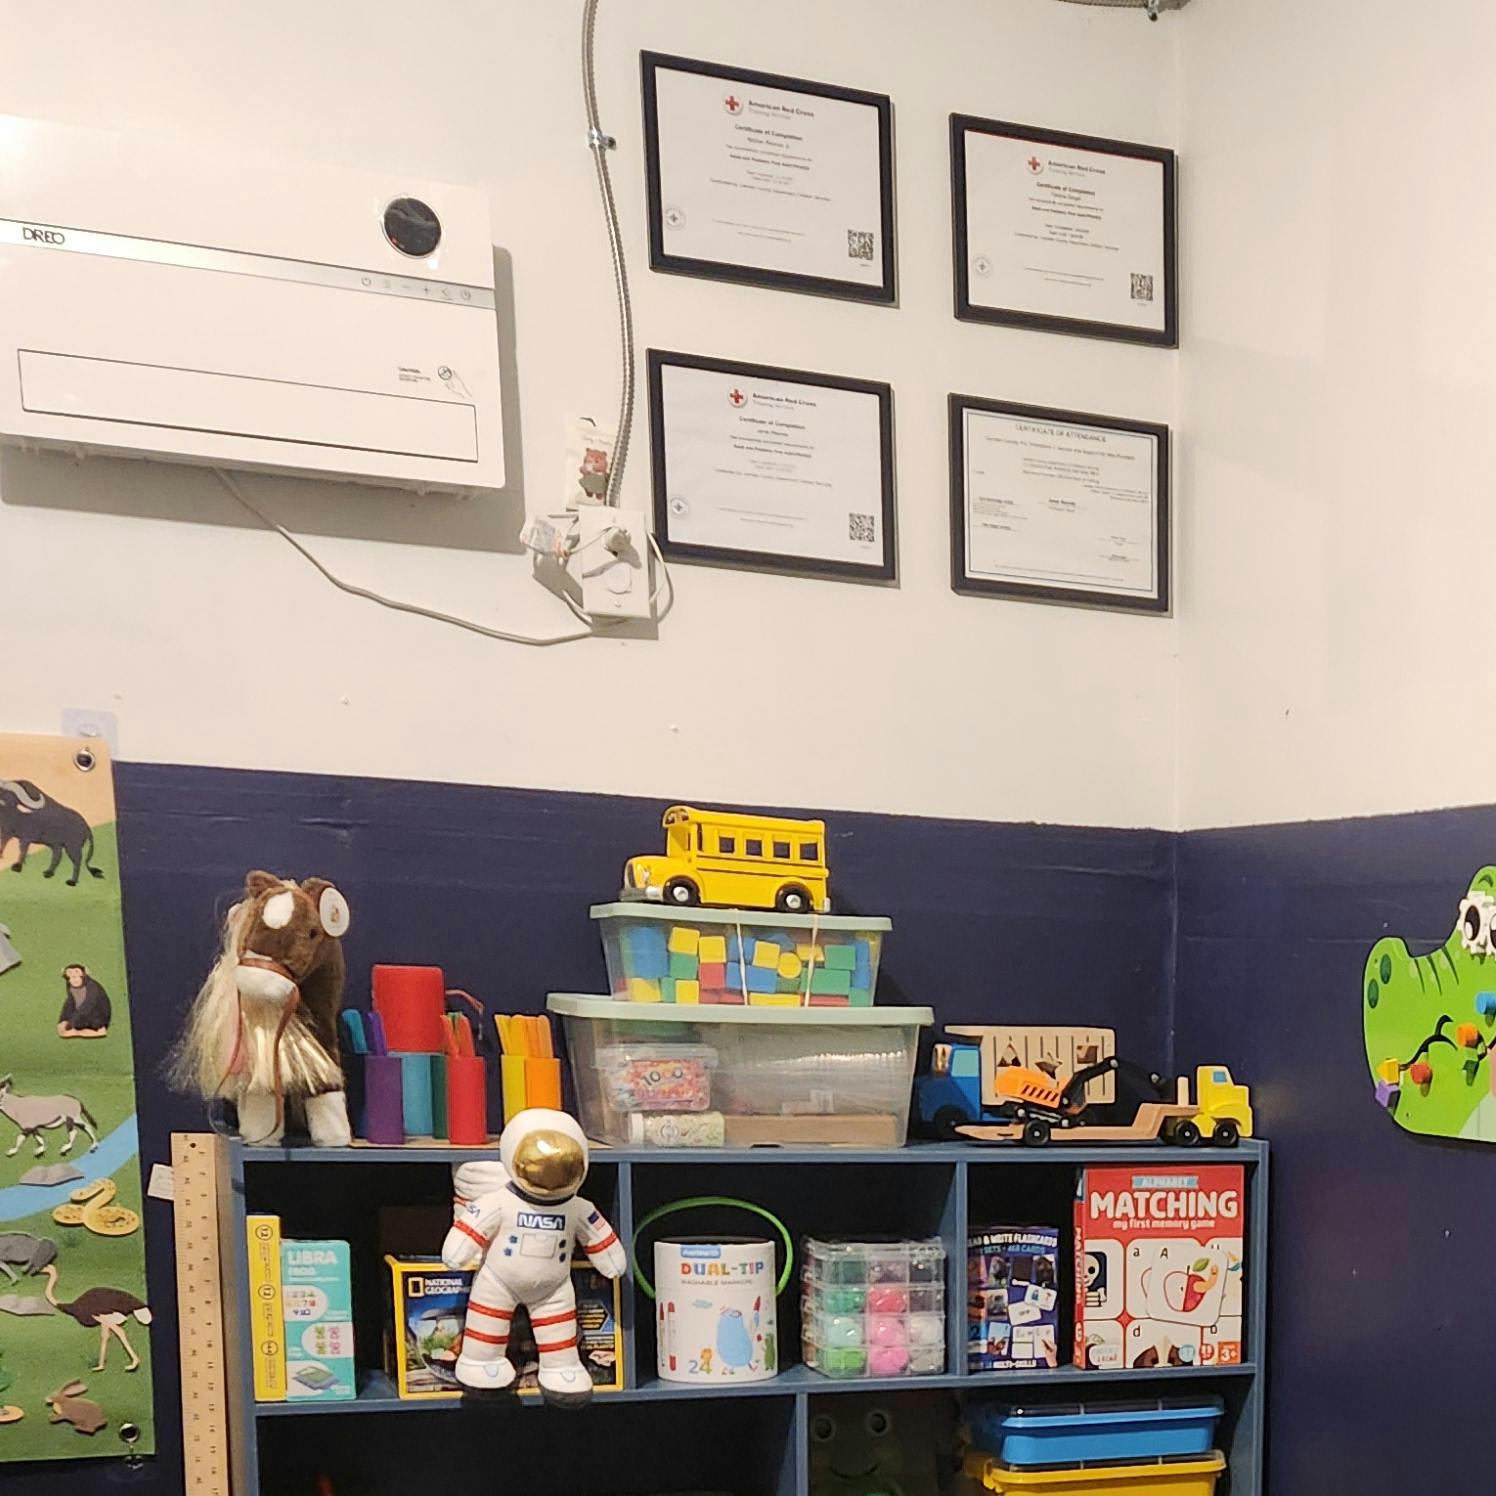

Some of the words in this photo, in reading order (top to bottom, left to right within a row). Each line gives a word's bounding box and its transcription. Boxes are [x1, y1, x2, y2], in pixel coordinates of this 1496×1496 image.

[795, 108, 814, 117] Cross
[1089, 166, 1106, 175] Cross
[23, 227, 65, 245] DREO
[798, 399, 816, 407] Cross
[1056, 429, 1064, 437] OF
[1065, 431, 1106, 443] ATTENDANCE
[641, 1067, 683, 1086] 100
[1090, 1190, 1238, 1219] MATCHING
[519, 1215, 563, 1229] NASA
[1113, 1219, 1128, 1231] my
[1129, 1217, 1151, 1229] first
[1152, 1219, 1190, 1231] memory
[1190, 1219, 1216, 1231] game
[261, 1228, 269, 1238] 12
[1014, 1233, 1057, 1248] FLASHCARDS
[287, 1250, 338, 1264] LIBRA
[1133, 1247, 1140, 1257] a
[1160, 1247, 1168, 1259] A
[681, 1262, 763, 1276] DUAL-TIP
[425, 1278, 463, 1286] NATIONAL
[264, 1287, 272, 1297] 12
[1132, 1325, 1140, 1337] d
[1221, 1349, 1237, 1361] 3+
[688, 1360, 713, 1374] 24
